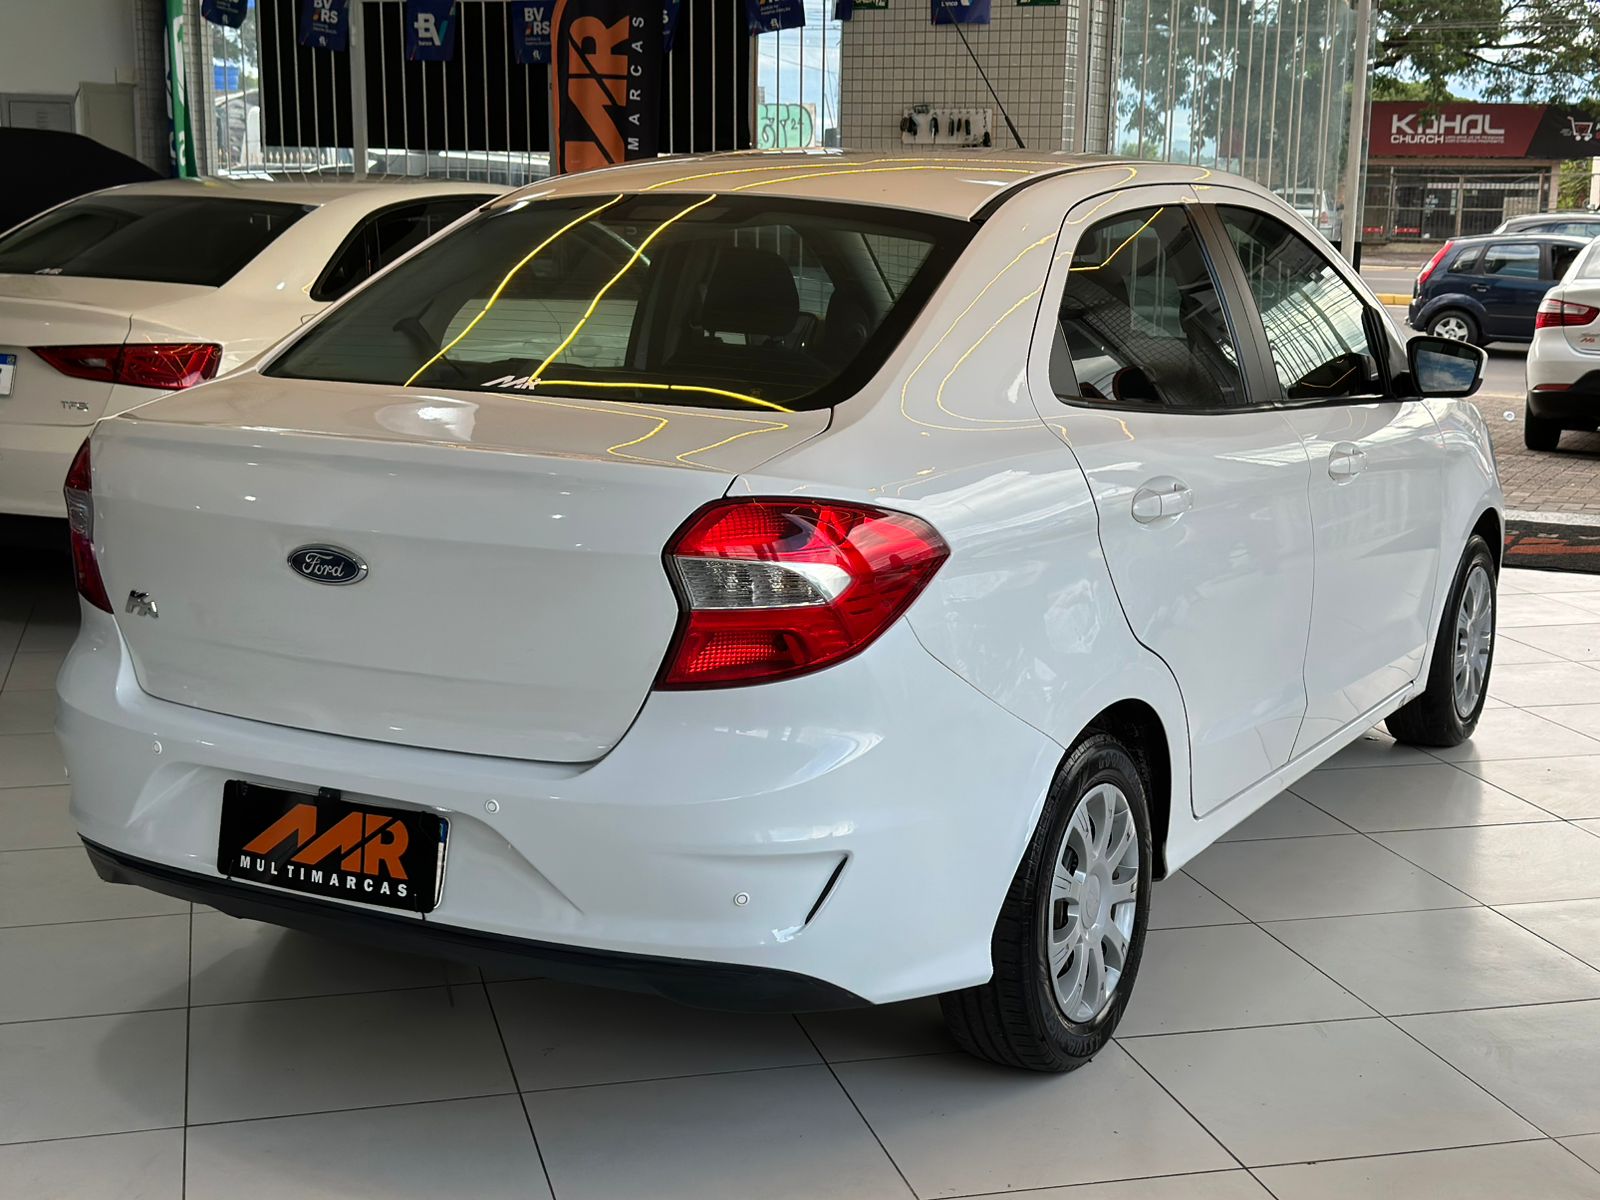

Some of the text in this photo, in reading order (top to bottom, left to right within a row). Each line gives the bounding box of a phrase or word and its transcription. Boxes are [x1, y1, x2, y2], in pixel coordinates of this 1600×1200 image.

[320, 9, 338, 25] RS
[524, 7, 544, 22] BV
[1390, 134, 1445, 144] CHURCH
[302, 552, 345, 577] Ford
[239, 854, 408, 897] MULTIMARCAS
